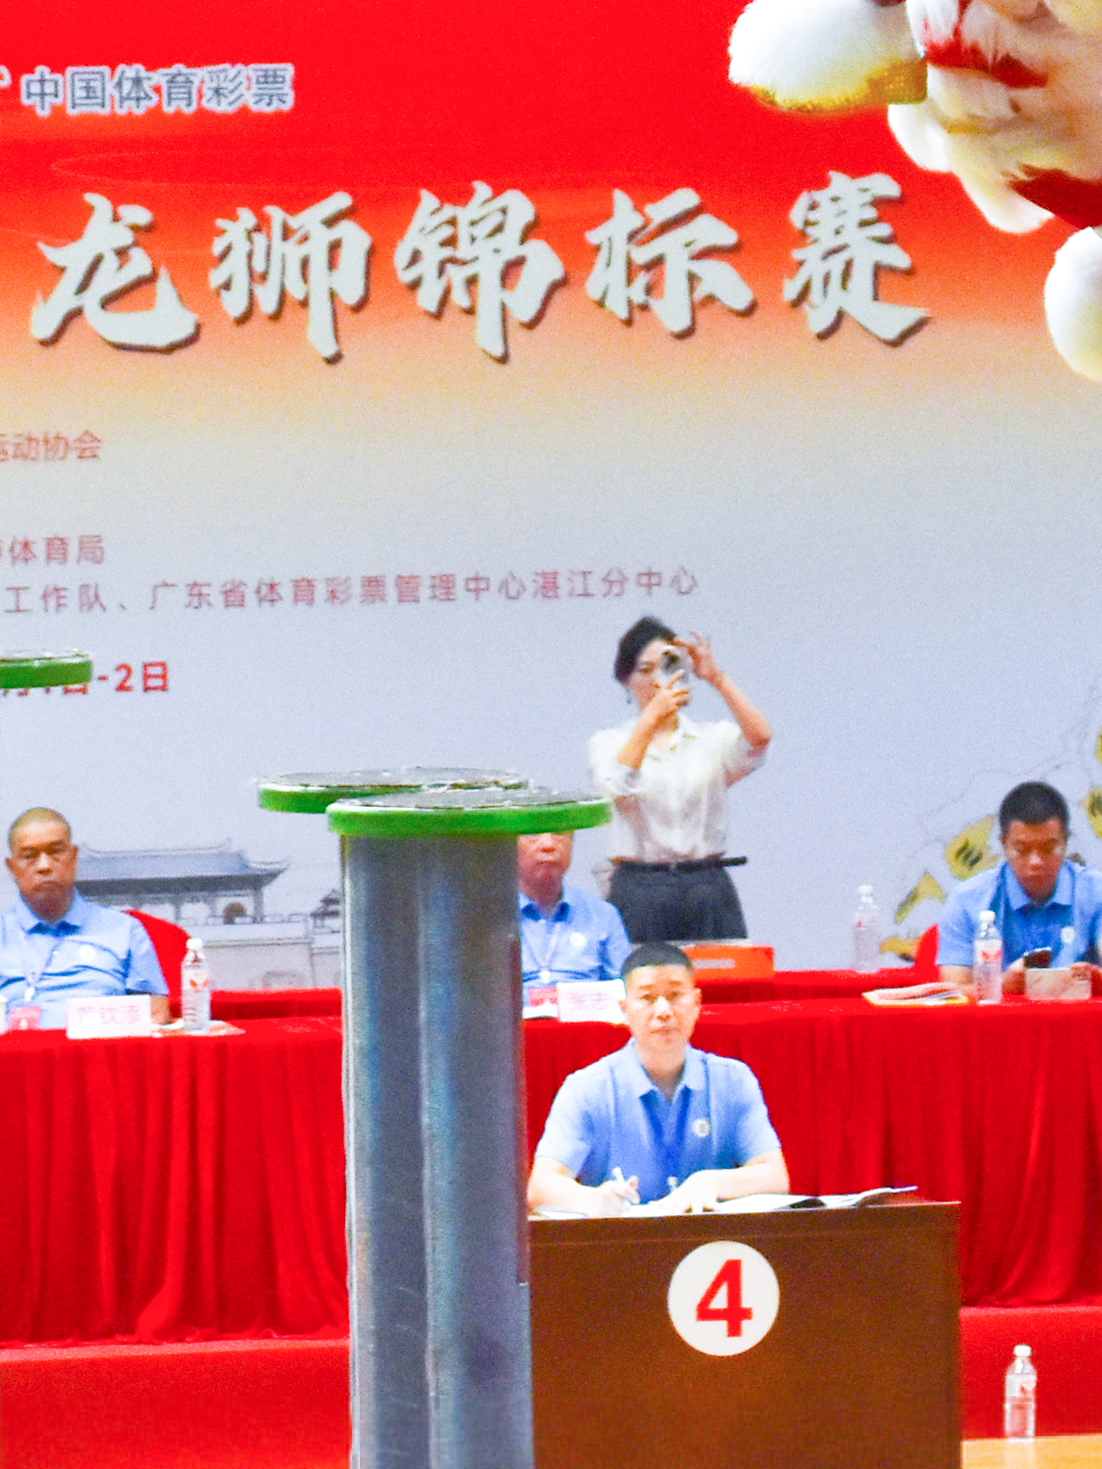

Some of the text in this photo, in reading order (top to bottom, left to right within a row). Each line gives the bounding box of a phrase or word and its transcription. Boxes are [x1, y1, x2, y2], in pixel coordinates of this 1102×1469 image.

[23, 65, 293, 114] 中国体育彩票
[30, 170, 932, 362] 龙狮锦标赛
[0, 533, 105, 565] 体育局
[696, 1258, 753, 1338] 4
